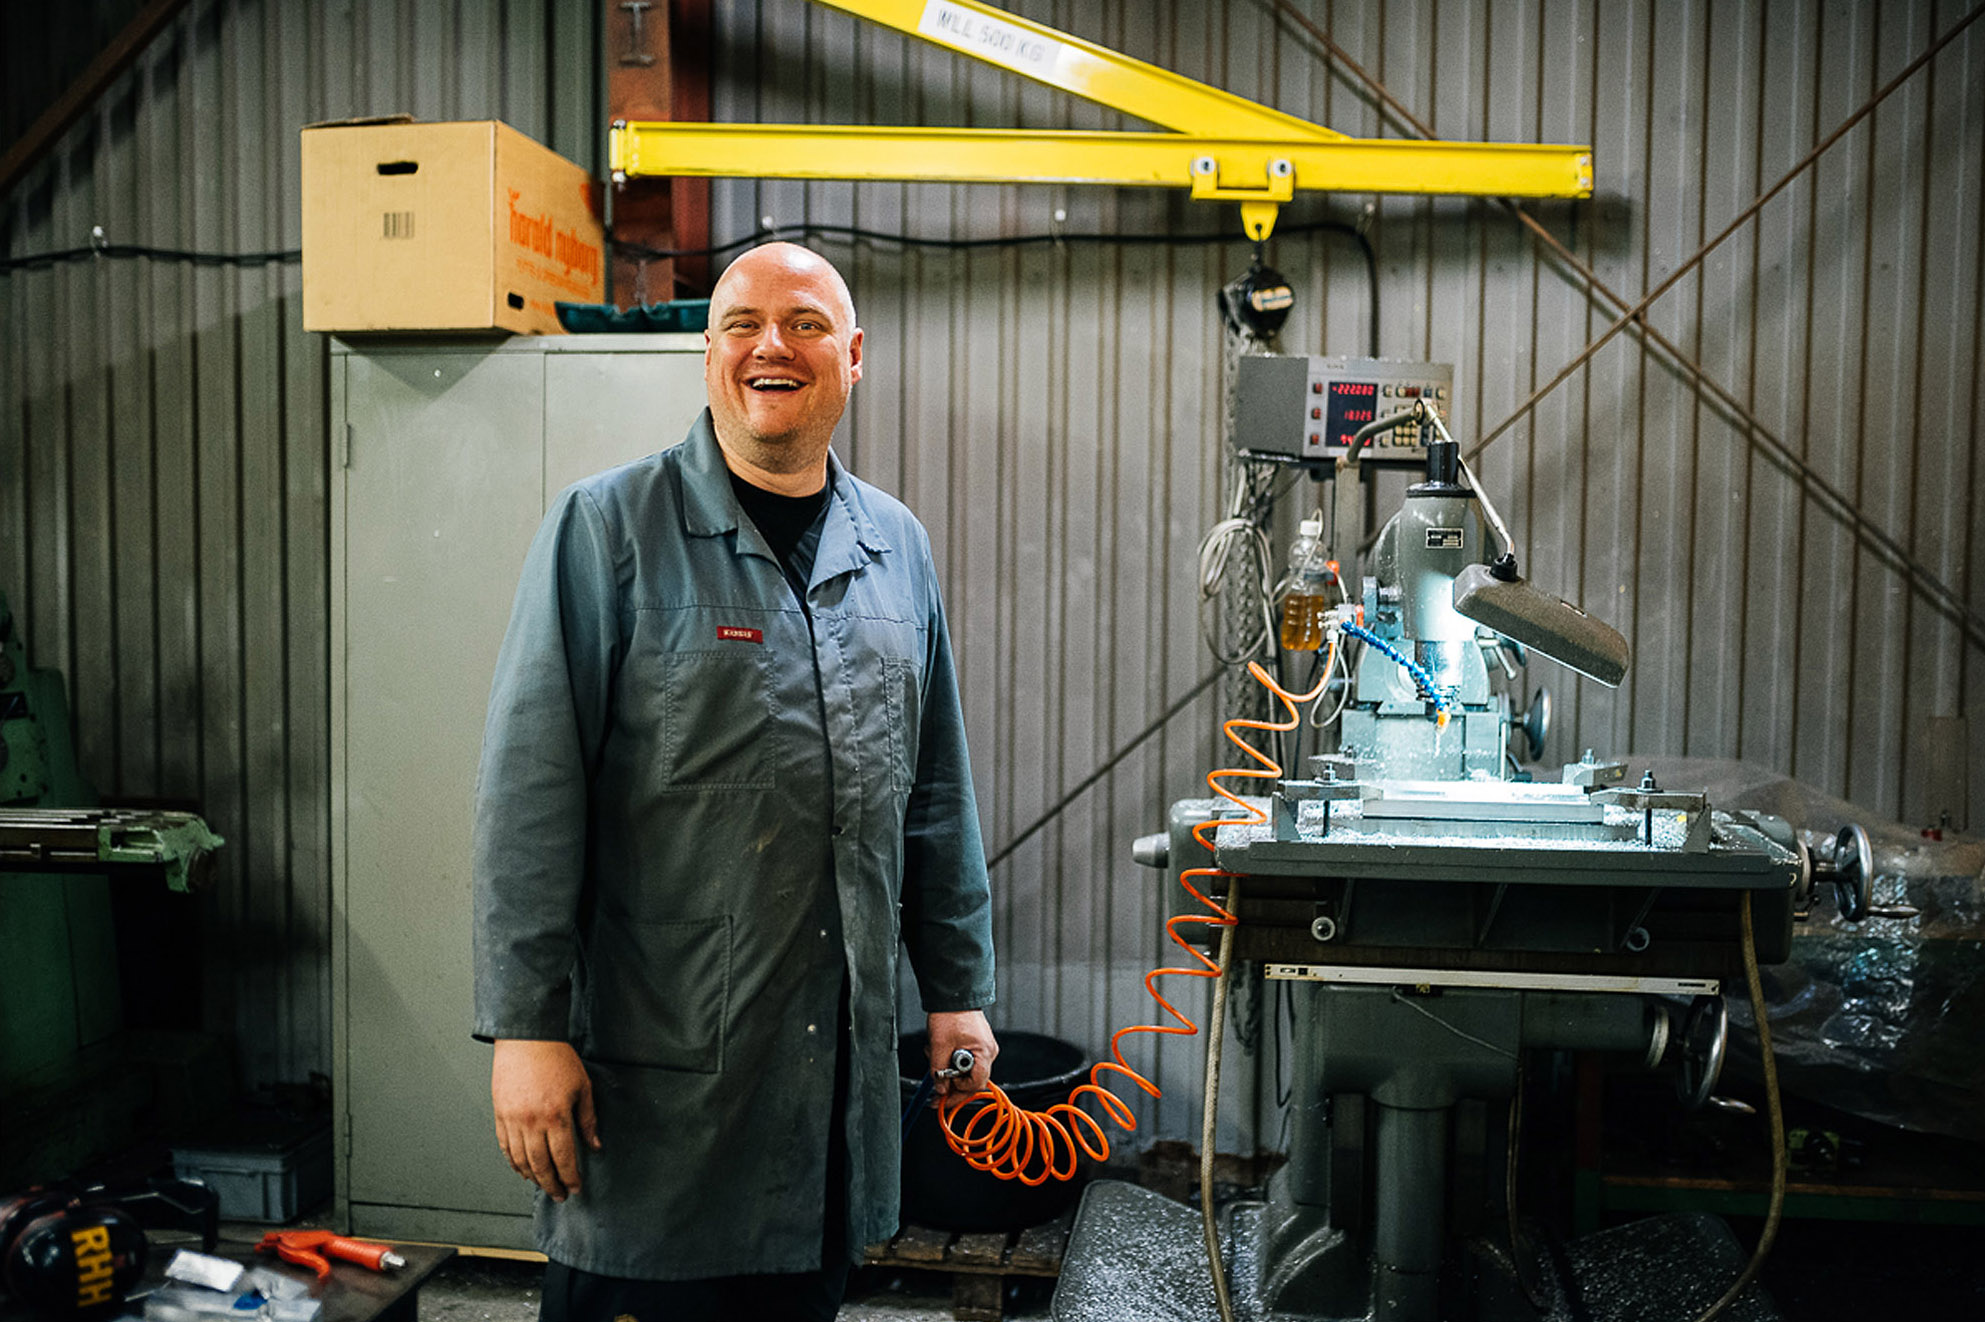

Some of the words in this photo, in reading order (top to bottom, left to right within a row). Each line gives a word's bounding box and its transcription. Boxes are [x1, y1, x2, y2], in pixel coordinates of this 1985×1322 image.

[937, 9, 972, 39] WLL
[979, 25, 1015, 51] 500
[1016, 39, 1045, 62] KG
[555, 228, 599, 286] nyborg
[71, 1225, 114, 1308] RHH
